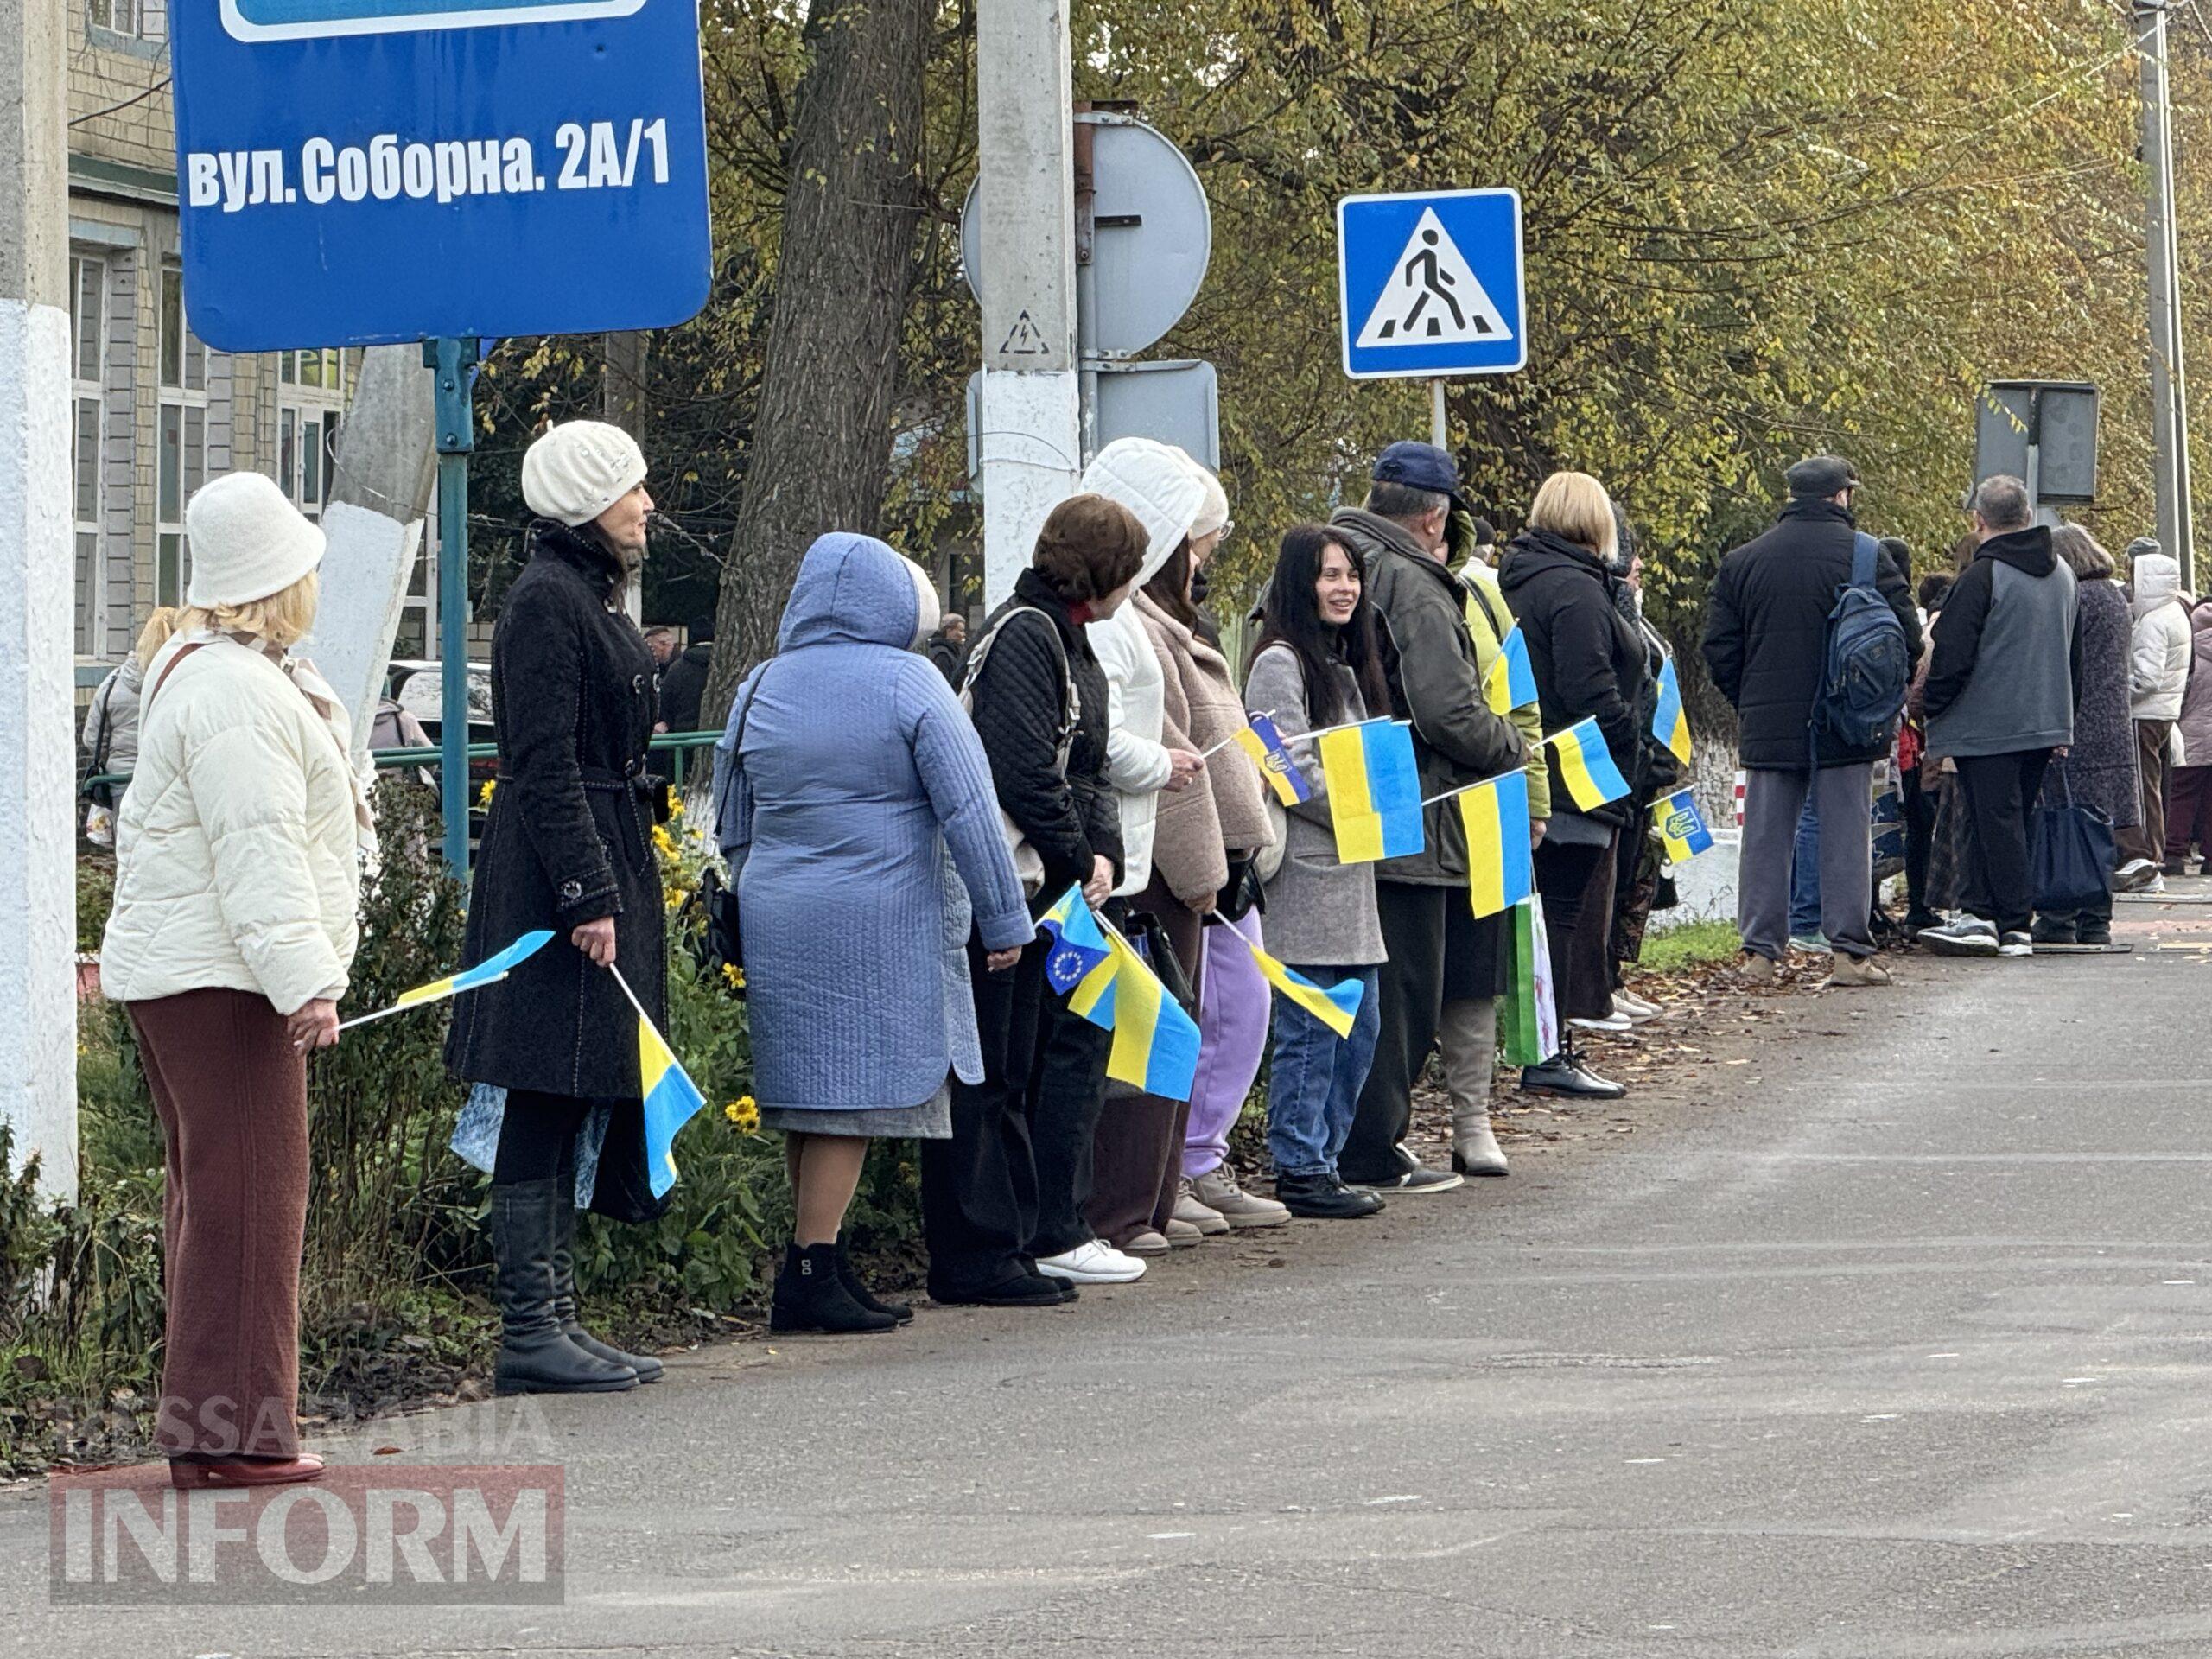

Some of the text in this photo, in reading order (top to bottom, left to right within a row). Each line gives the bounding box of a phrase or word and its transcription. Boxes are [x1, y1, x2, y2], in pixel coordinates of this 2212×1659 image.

[188, 118, 669, 213] вул. Соборна. 2А/1
